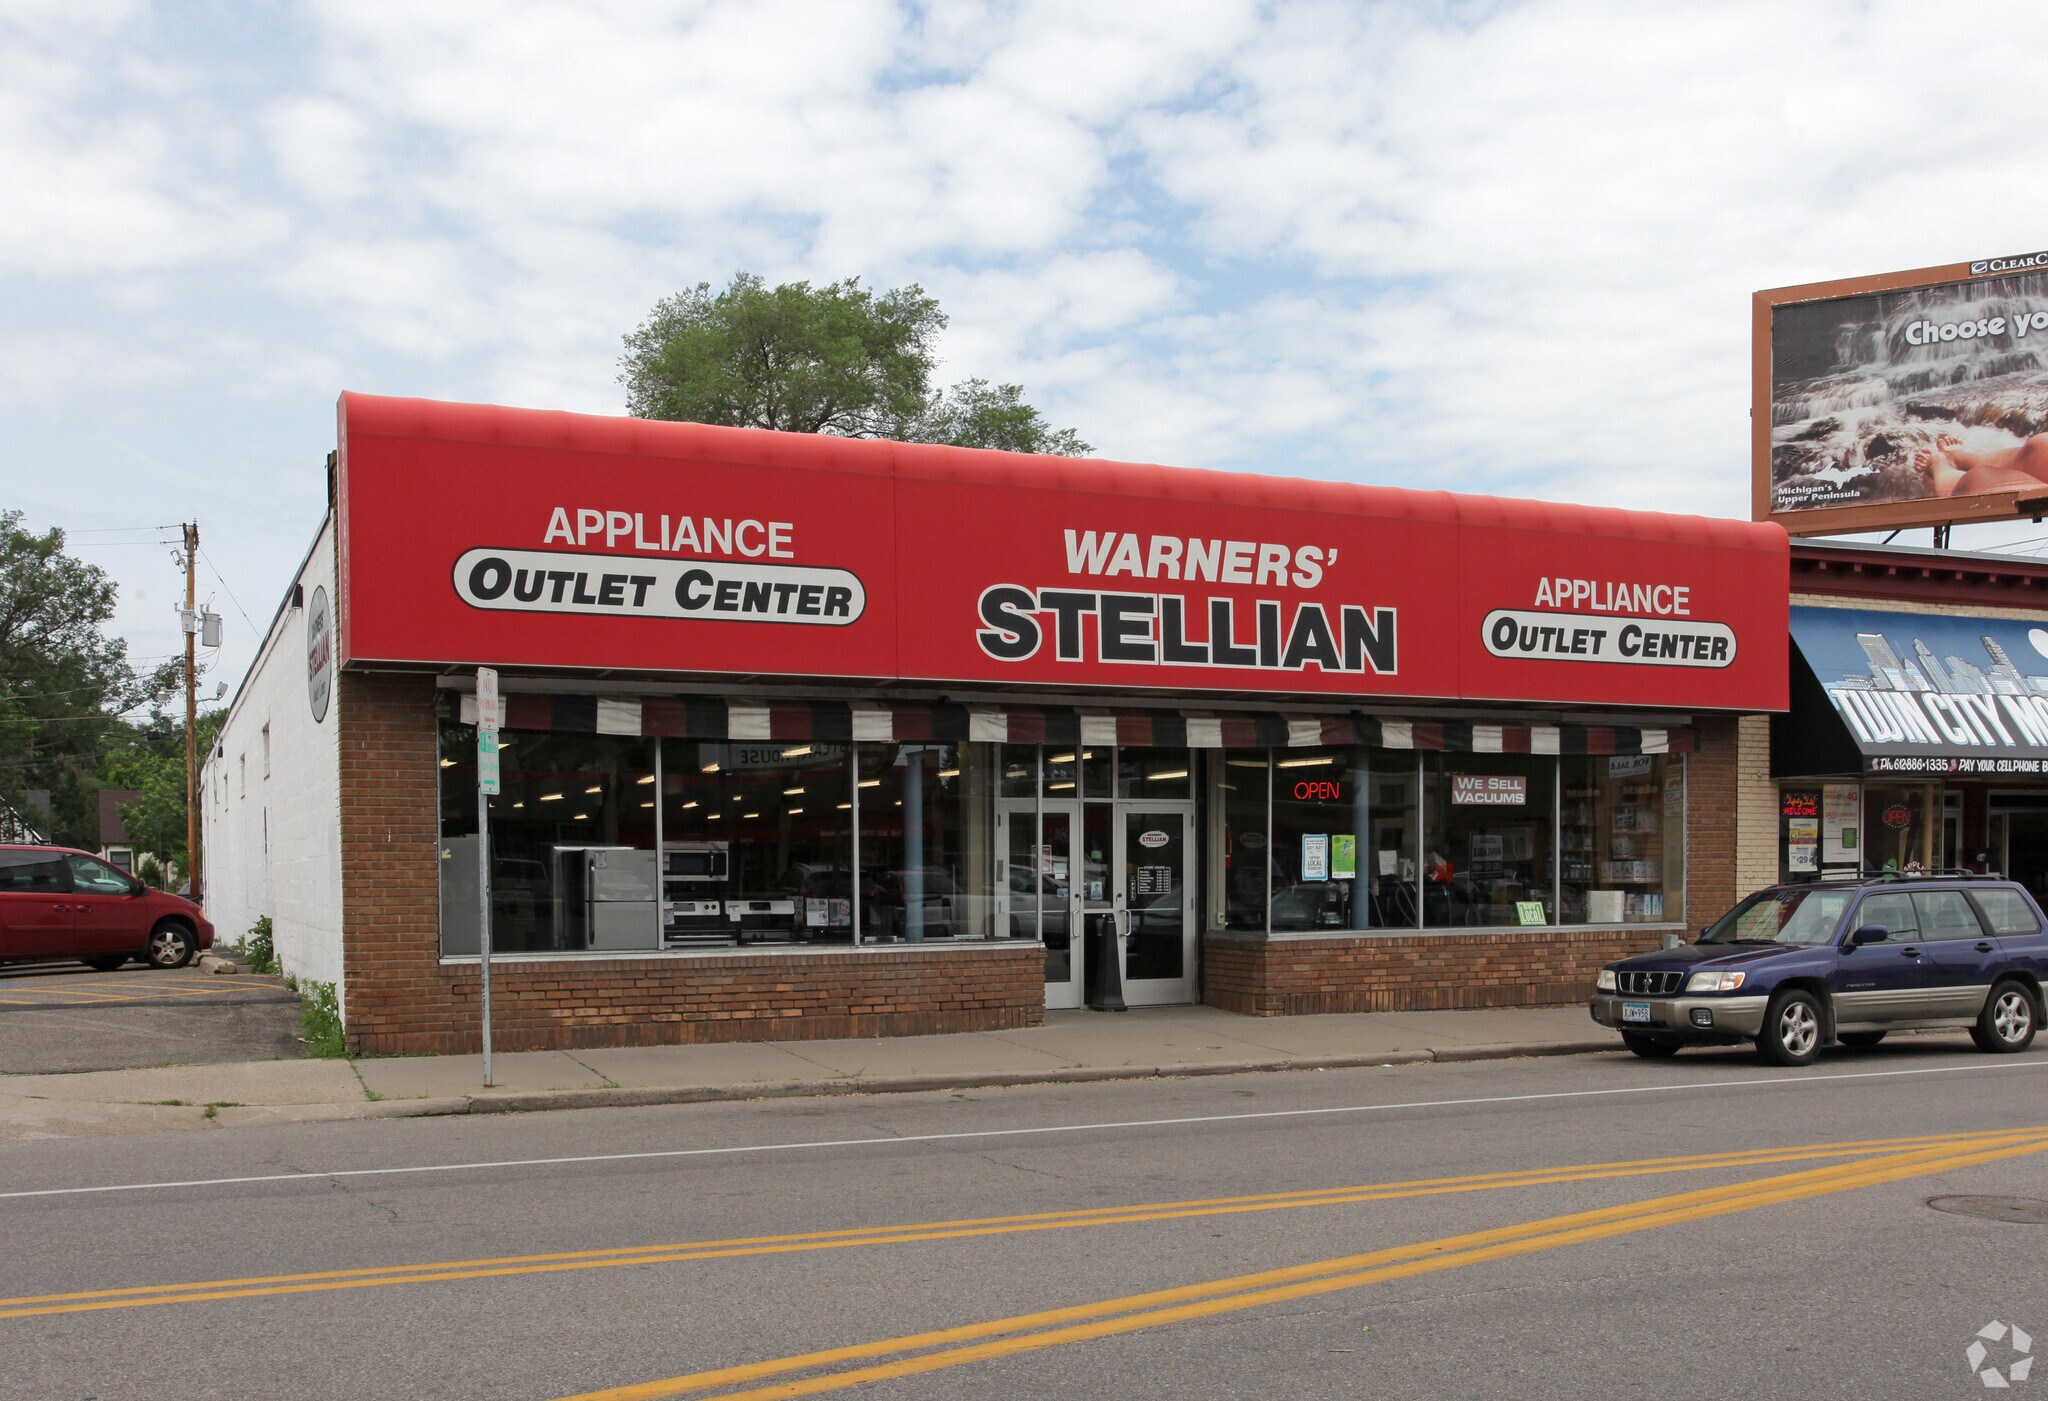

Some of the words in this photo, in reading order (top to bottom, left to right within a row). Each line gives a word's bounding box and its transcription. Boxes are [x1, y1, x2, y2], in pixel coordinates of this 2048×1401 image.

[1906, 316, 2006, 345] Choose
[1778, 484, 1832, 495] Michigan's
[1778, 495, 1809, 504] Upper
[1811, 490, 1860, 501] Peninsula
[543, 507, 795, 558] APPLIANCE
[1064, 529, 1338, 588] WARNERS'
[468, 557, 657, 607] OUTLET
[674, 569, 853, 617] CENTER
[1534, 577, 1690, 615] APPLIANCE
[976, 583, 1398, 675] STELLIAN
[1491, 616, 1607, 655] OUTLET
[1618, 624, 1729, 661] CENTER
[309, 629, 330, 682] STELLIAN
[1829, 688, 1943, 744] TWIN
[1923, 692, 2017, 747] CITY
[1958, 759, 1976, 771] PAY
[1976, 759, 1995, 772] YOUR
[1294, 781, 1340, 799] OPEN
[1454, 790, 1524, 803] VACUUMS
[1457, 777, 1483, 789] WE
[1488, 778, 1522, 790] SELL
[1882, 810, 1911, 824] OPEN
[1520, 906, 1543, 922] LOCAL
